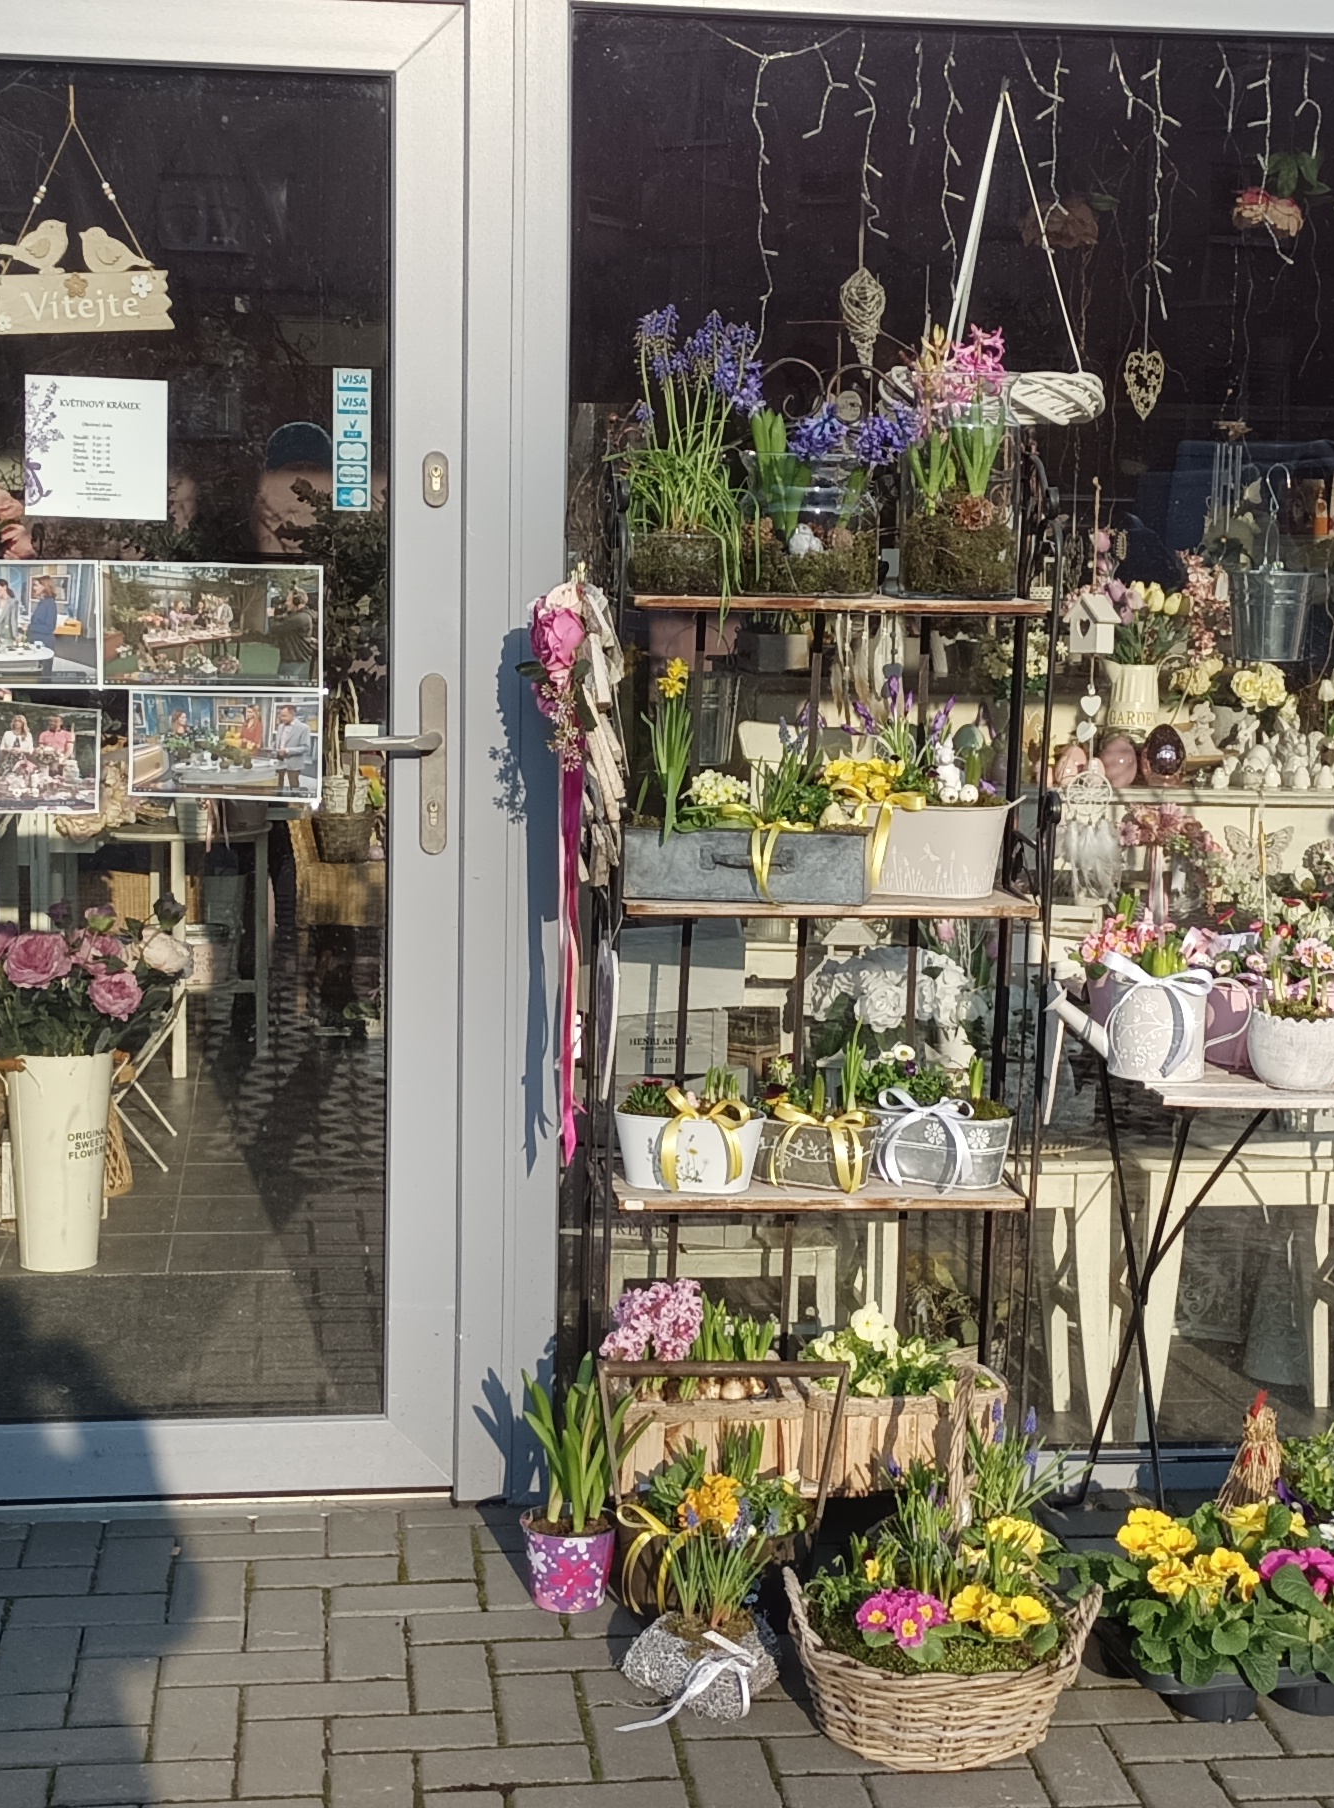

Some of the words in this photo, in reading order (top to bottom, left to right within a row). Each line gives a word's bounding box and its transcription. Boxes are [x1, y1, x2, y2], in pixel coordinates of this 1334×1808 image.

[20, 289, 140, 328] Vítejte
[342, 374, 366, 384] VISA
[59, 398, 105, 408] KVĚTINOVÝ
[106, 400, 141, 411] KRÁMEK
[342, 397, 366, 407] VISA
[629, 1037, 660, 1046] HENRI
[661, 1035, 693, 1046] ABÉ
[74, 1136, 104, 1150] SWEET
